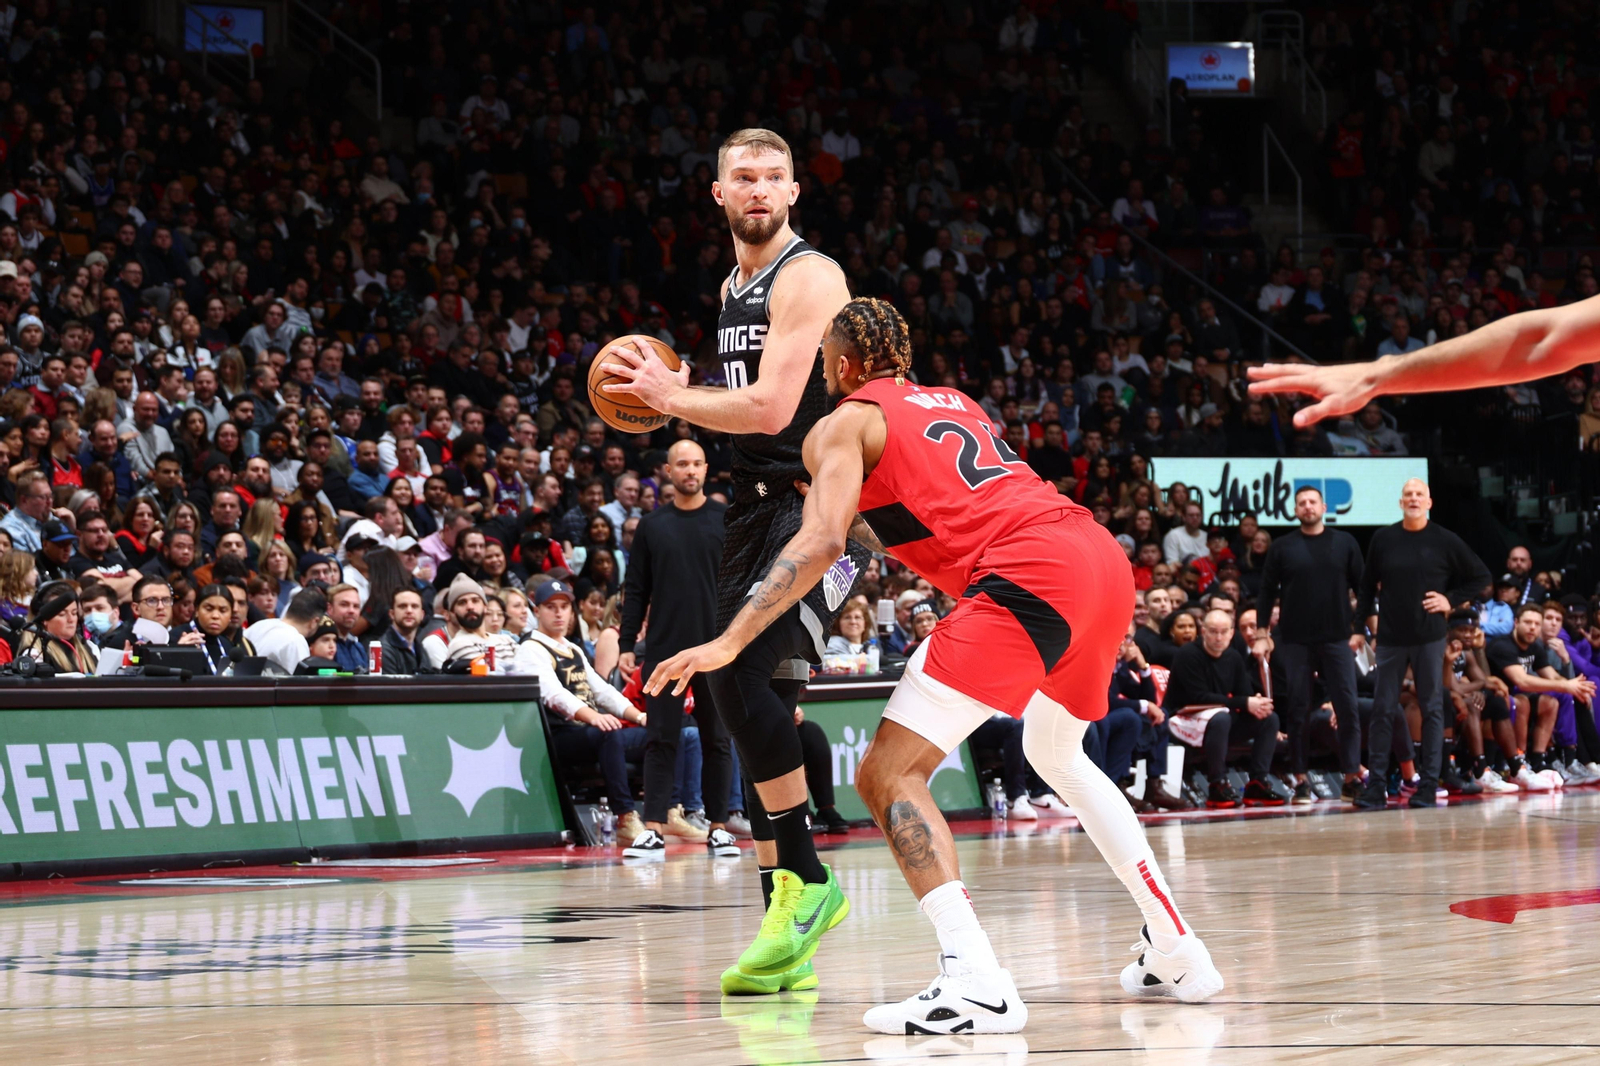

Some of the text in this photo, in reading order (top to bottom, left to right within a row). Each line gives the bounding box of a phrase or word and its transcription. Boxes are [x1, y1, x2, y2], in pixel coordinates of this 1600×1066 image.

[1185, 73, 1236, 82] AEROPLAN
[723, 360, 749, 391] 10
[1209, 458, 1297, 524] Milk
